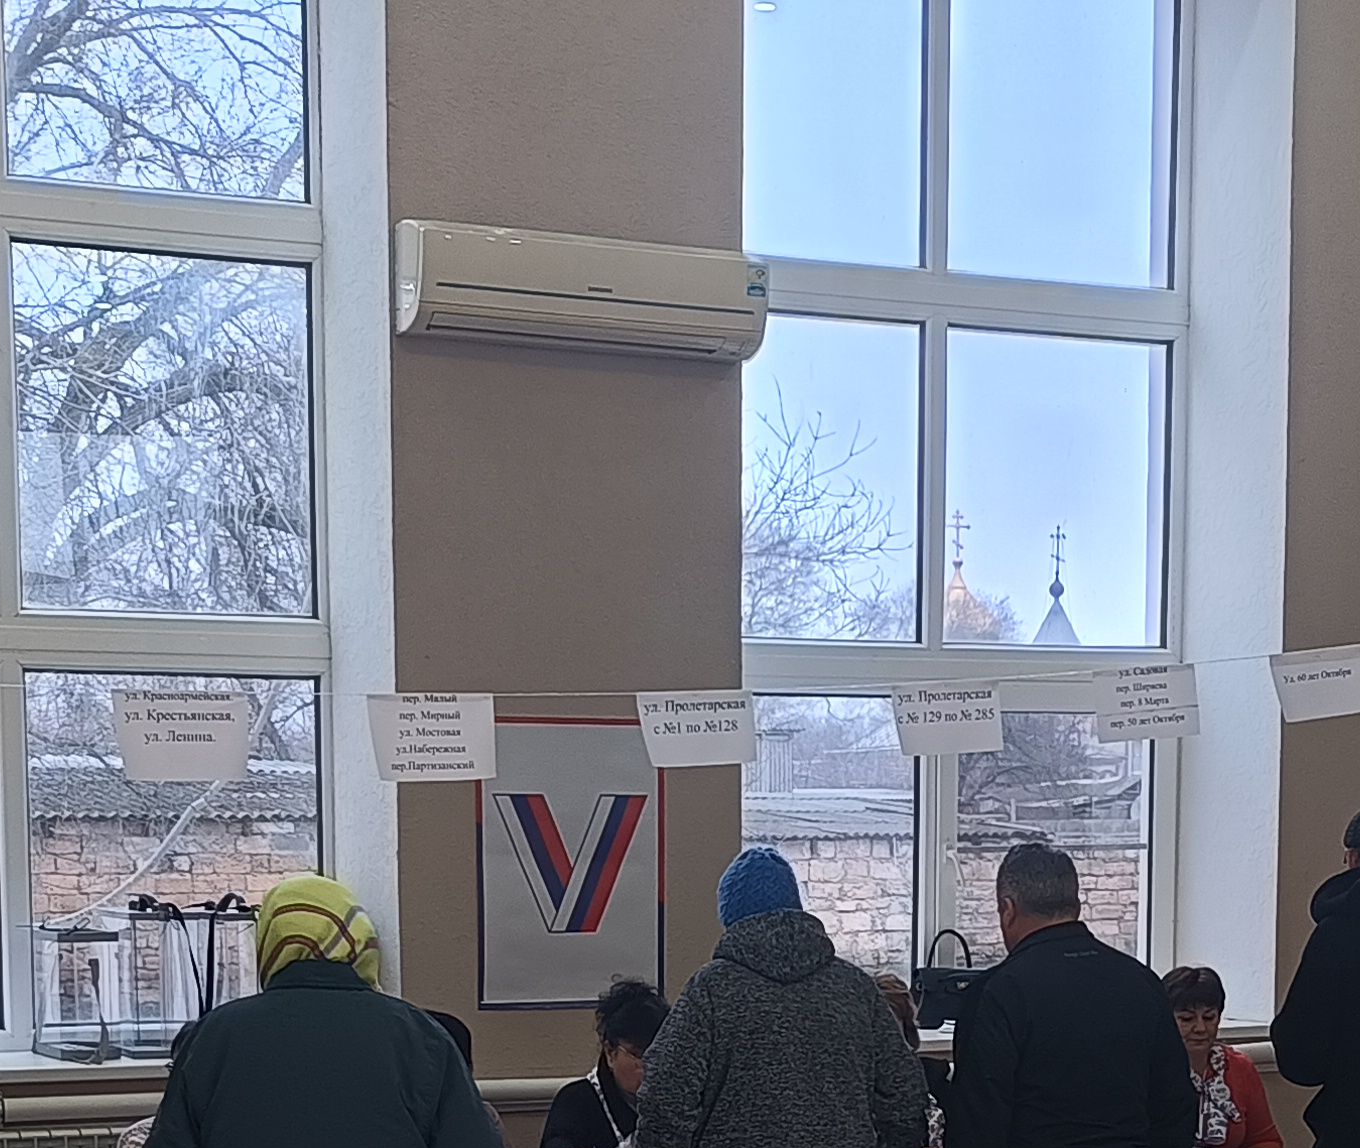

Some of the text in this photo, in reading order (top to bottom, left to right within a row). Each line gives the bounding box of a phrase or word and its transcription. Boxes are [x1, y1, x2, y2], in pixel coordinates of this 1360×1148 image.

[1321, 668, 1352, 679] Октября
[124, 692, 140, 702] ул.
[402, 694, 458, 705] пер. Малый
[898, 690, 992, 706] ул. Пролетарская
[1144, 697, 1170, 707] Марта
[644, 700, 746, 716] ул. Пролетарская
[124, 709, 236, 723] ул. Крестьянская,
[399, 710, 461, 722] пер. Мирный
[906, 712, 919, 724] №
[923, 711, 942, 723] 129
[944, 714, 957, 722] по
[959, 710, 972, 722] №
[974, 708, 995, 720] 285
[1152, 713, 1185, 724] Октября
[399, 728, 461, 739] ул. Мостовая
[654, 720, 739, 735] с №1 по №128
[144, 730, 216, 745] ул. Ленина.
[396, 744, 466, 756] ул.Набережная
[391, 760, 475, 772] пер.Партизанский
